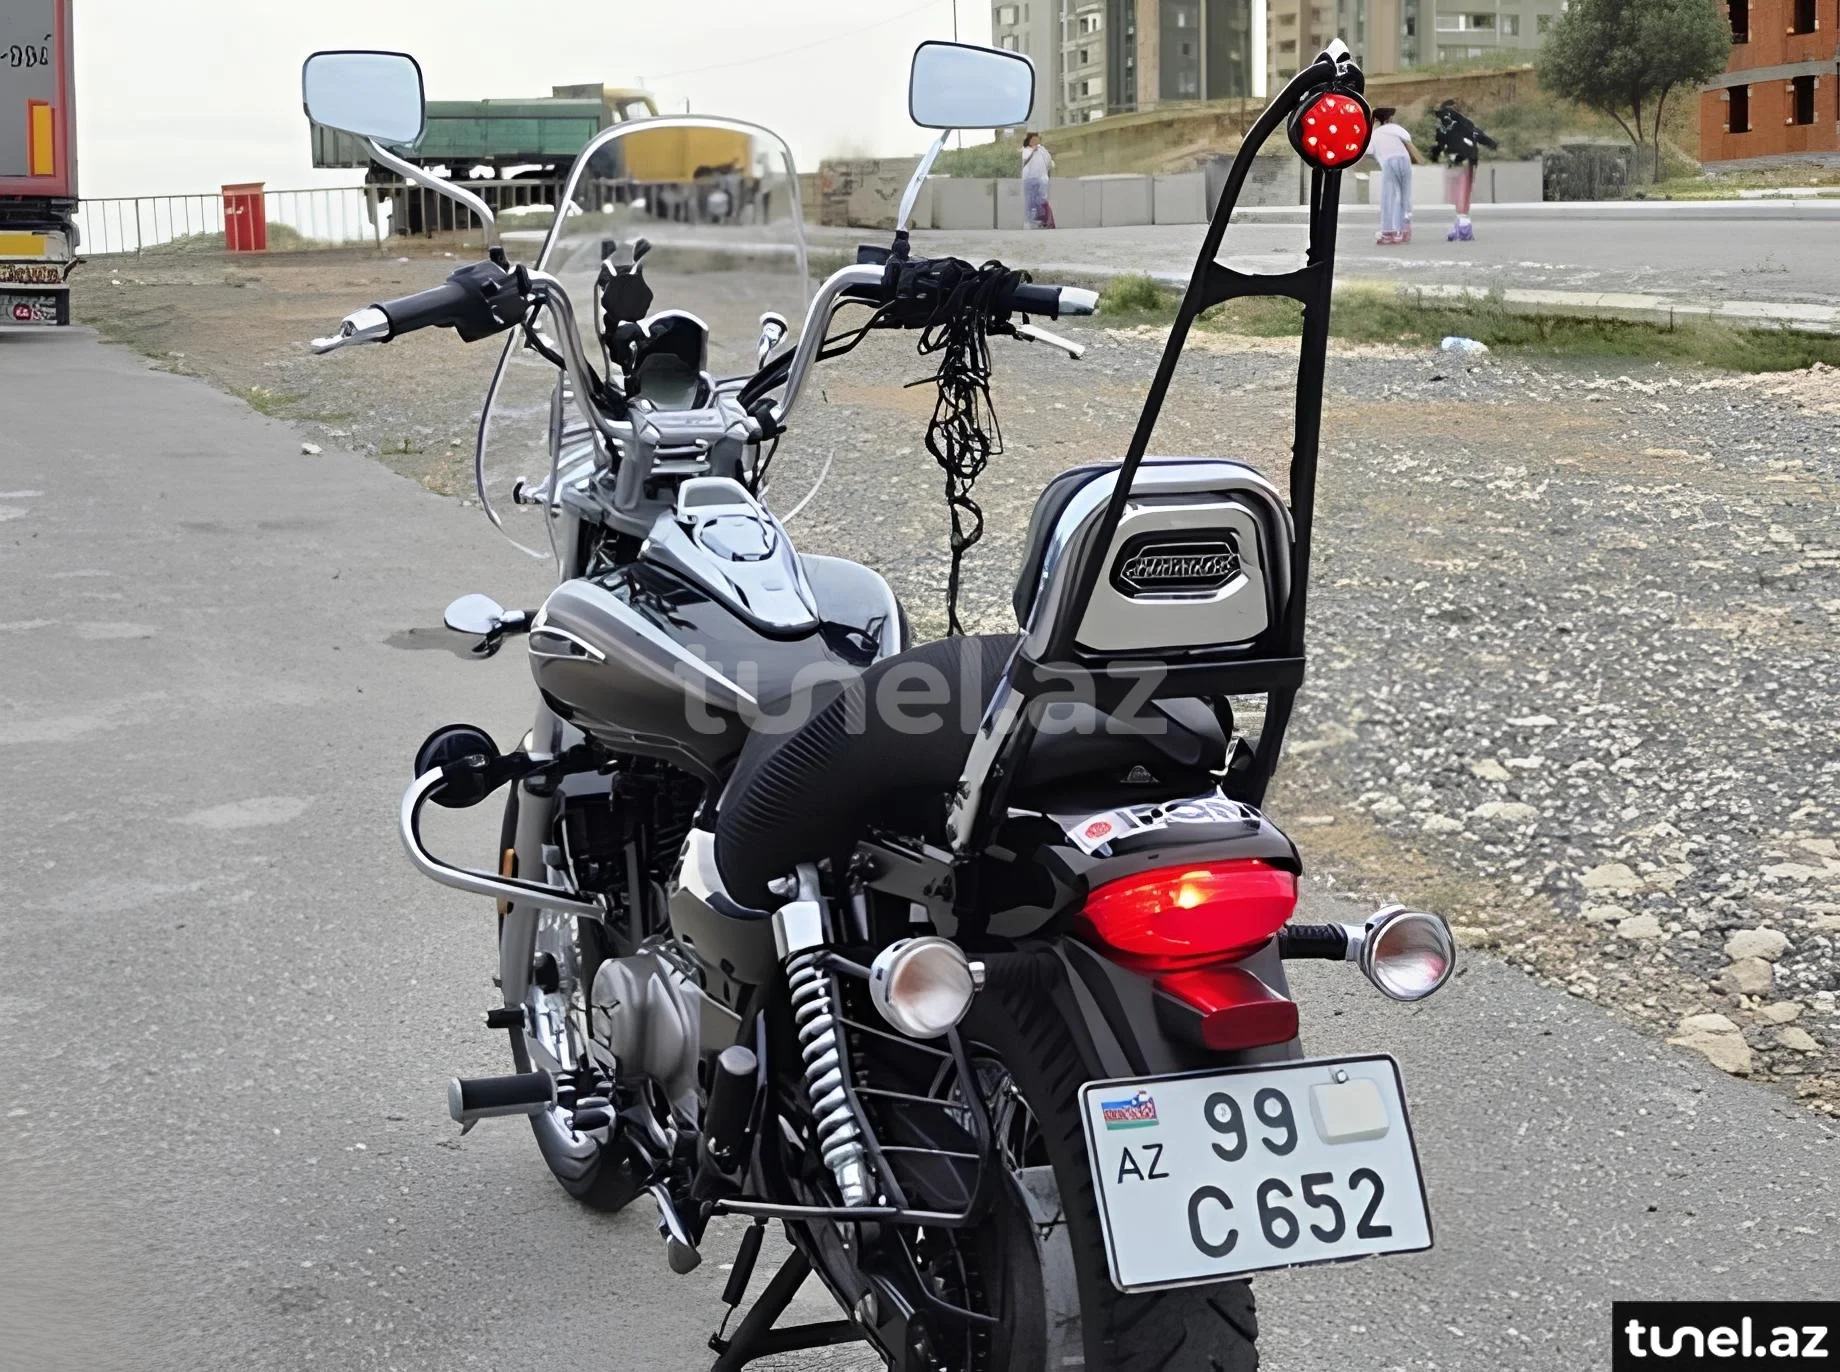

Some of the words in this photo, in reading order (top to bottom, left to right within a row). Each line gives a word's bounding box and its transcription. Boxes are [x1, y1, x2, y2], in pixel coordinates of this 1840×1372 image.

[1204, 1087, 1298, 1162] 99
[1117, 1143, 1169, 1184] AZ
[1188, 1185, 1239, 1258] C
[1256, 1167, 1392, 1249] 652
